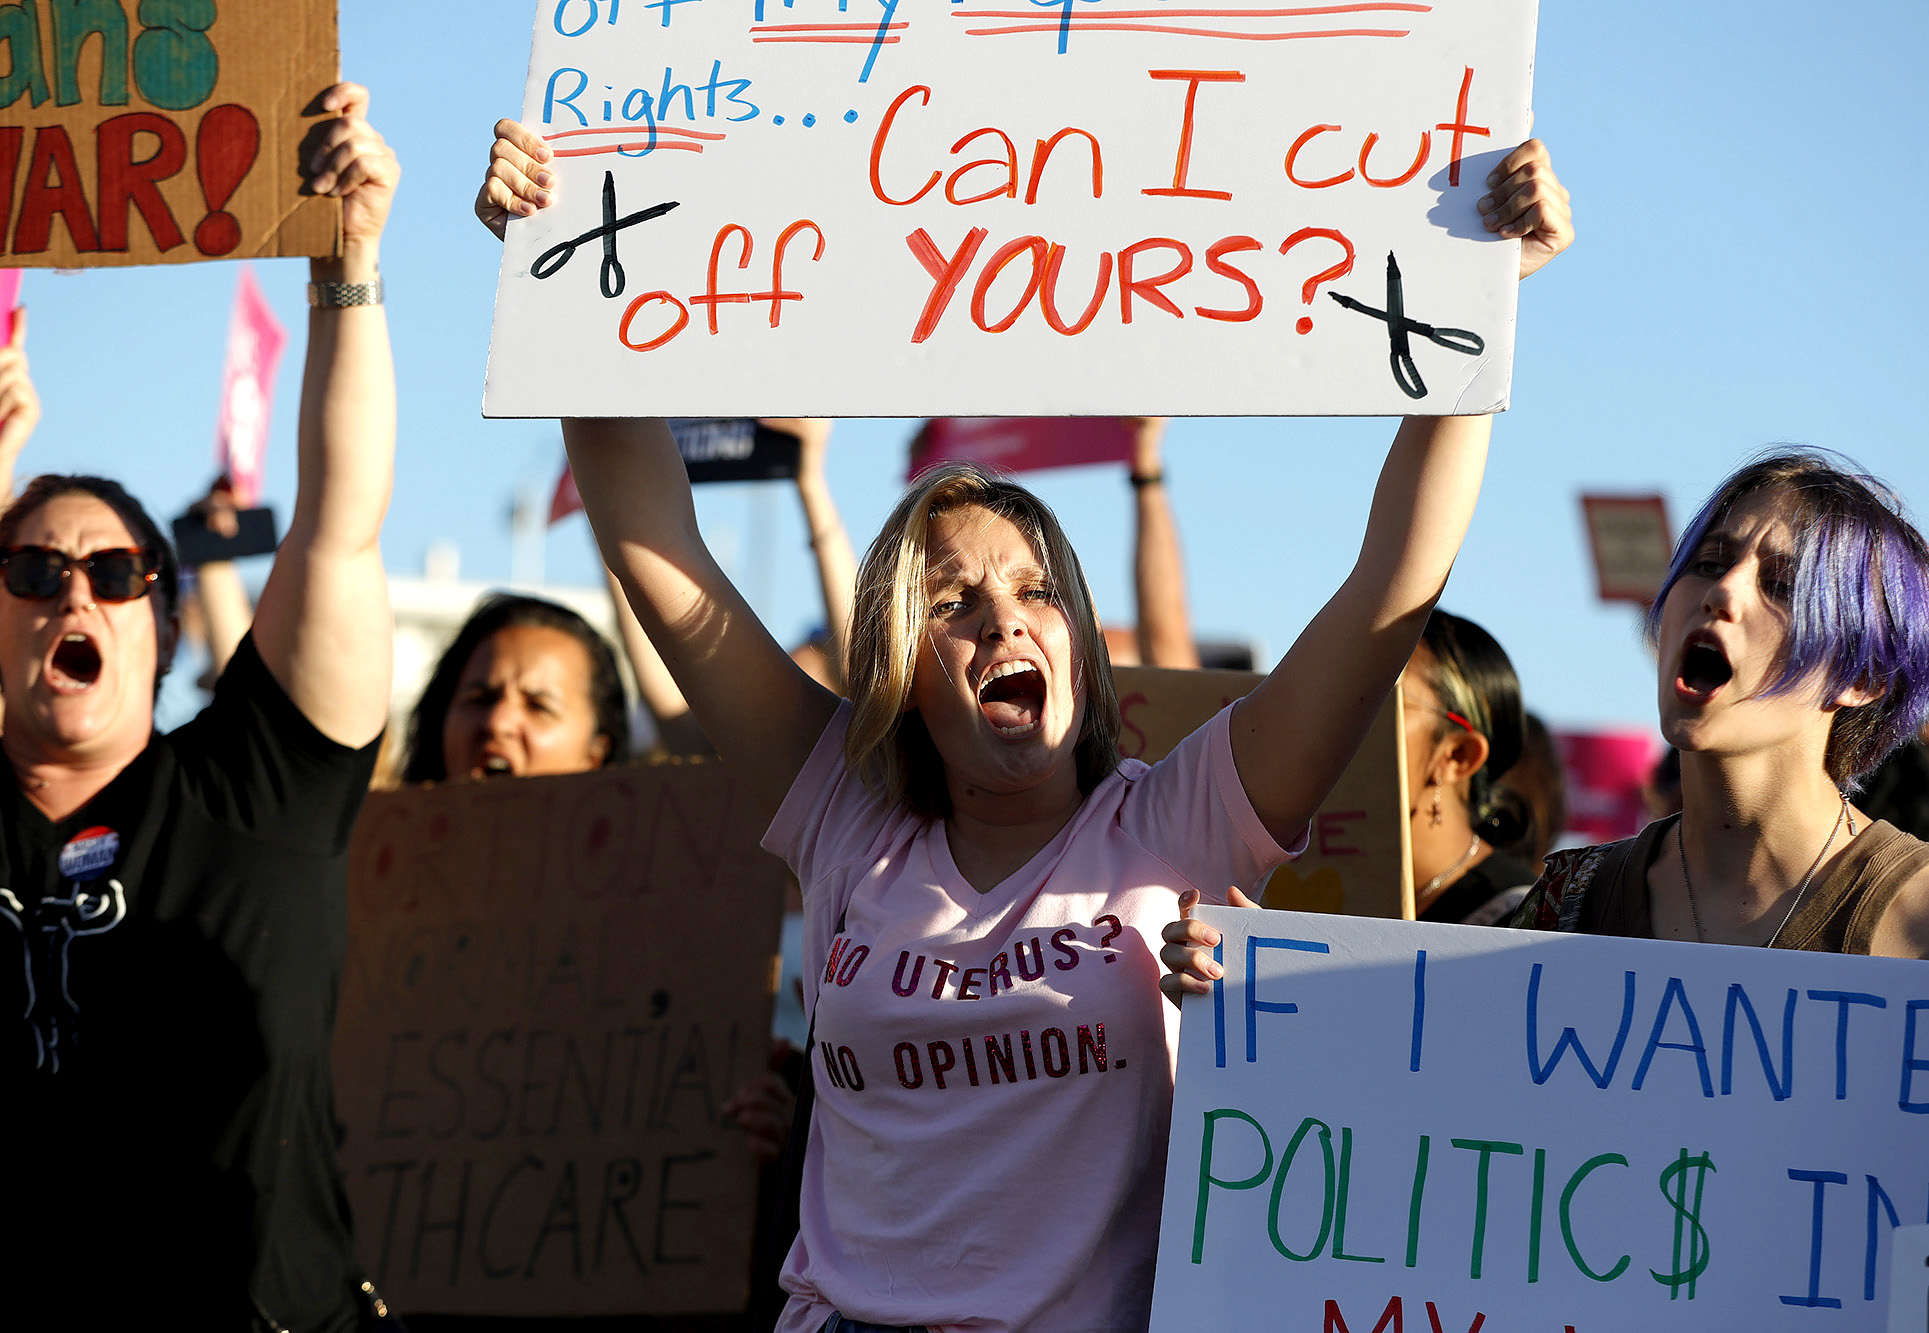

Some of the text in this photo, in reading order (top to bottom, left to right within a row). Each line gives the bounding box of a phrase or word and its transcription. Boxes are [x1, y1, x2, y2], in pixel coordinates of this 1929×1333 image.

[869, 85, 1103, 206] Can
[1141, 69, 1246, 202] I
[1284, 65, 1490, 189] cut
[619, 219, 1356, 352] off YOURS?
[824, 914, 1123, 1001] NO UTERUS?
[1212, 934, 1929, 1115] IF I WANTE
[374, 1018, 748, 1142] ESSENTIAL
[821, 1022, 1127, 1092] NO OPINION.
[366, 1149, 717, 1288] THCARE
[1191, 1108, 1717, 1301] POLITIC$
